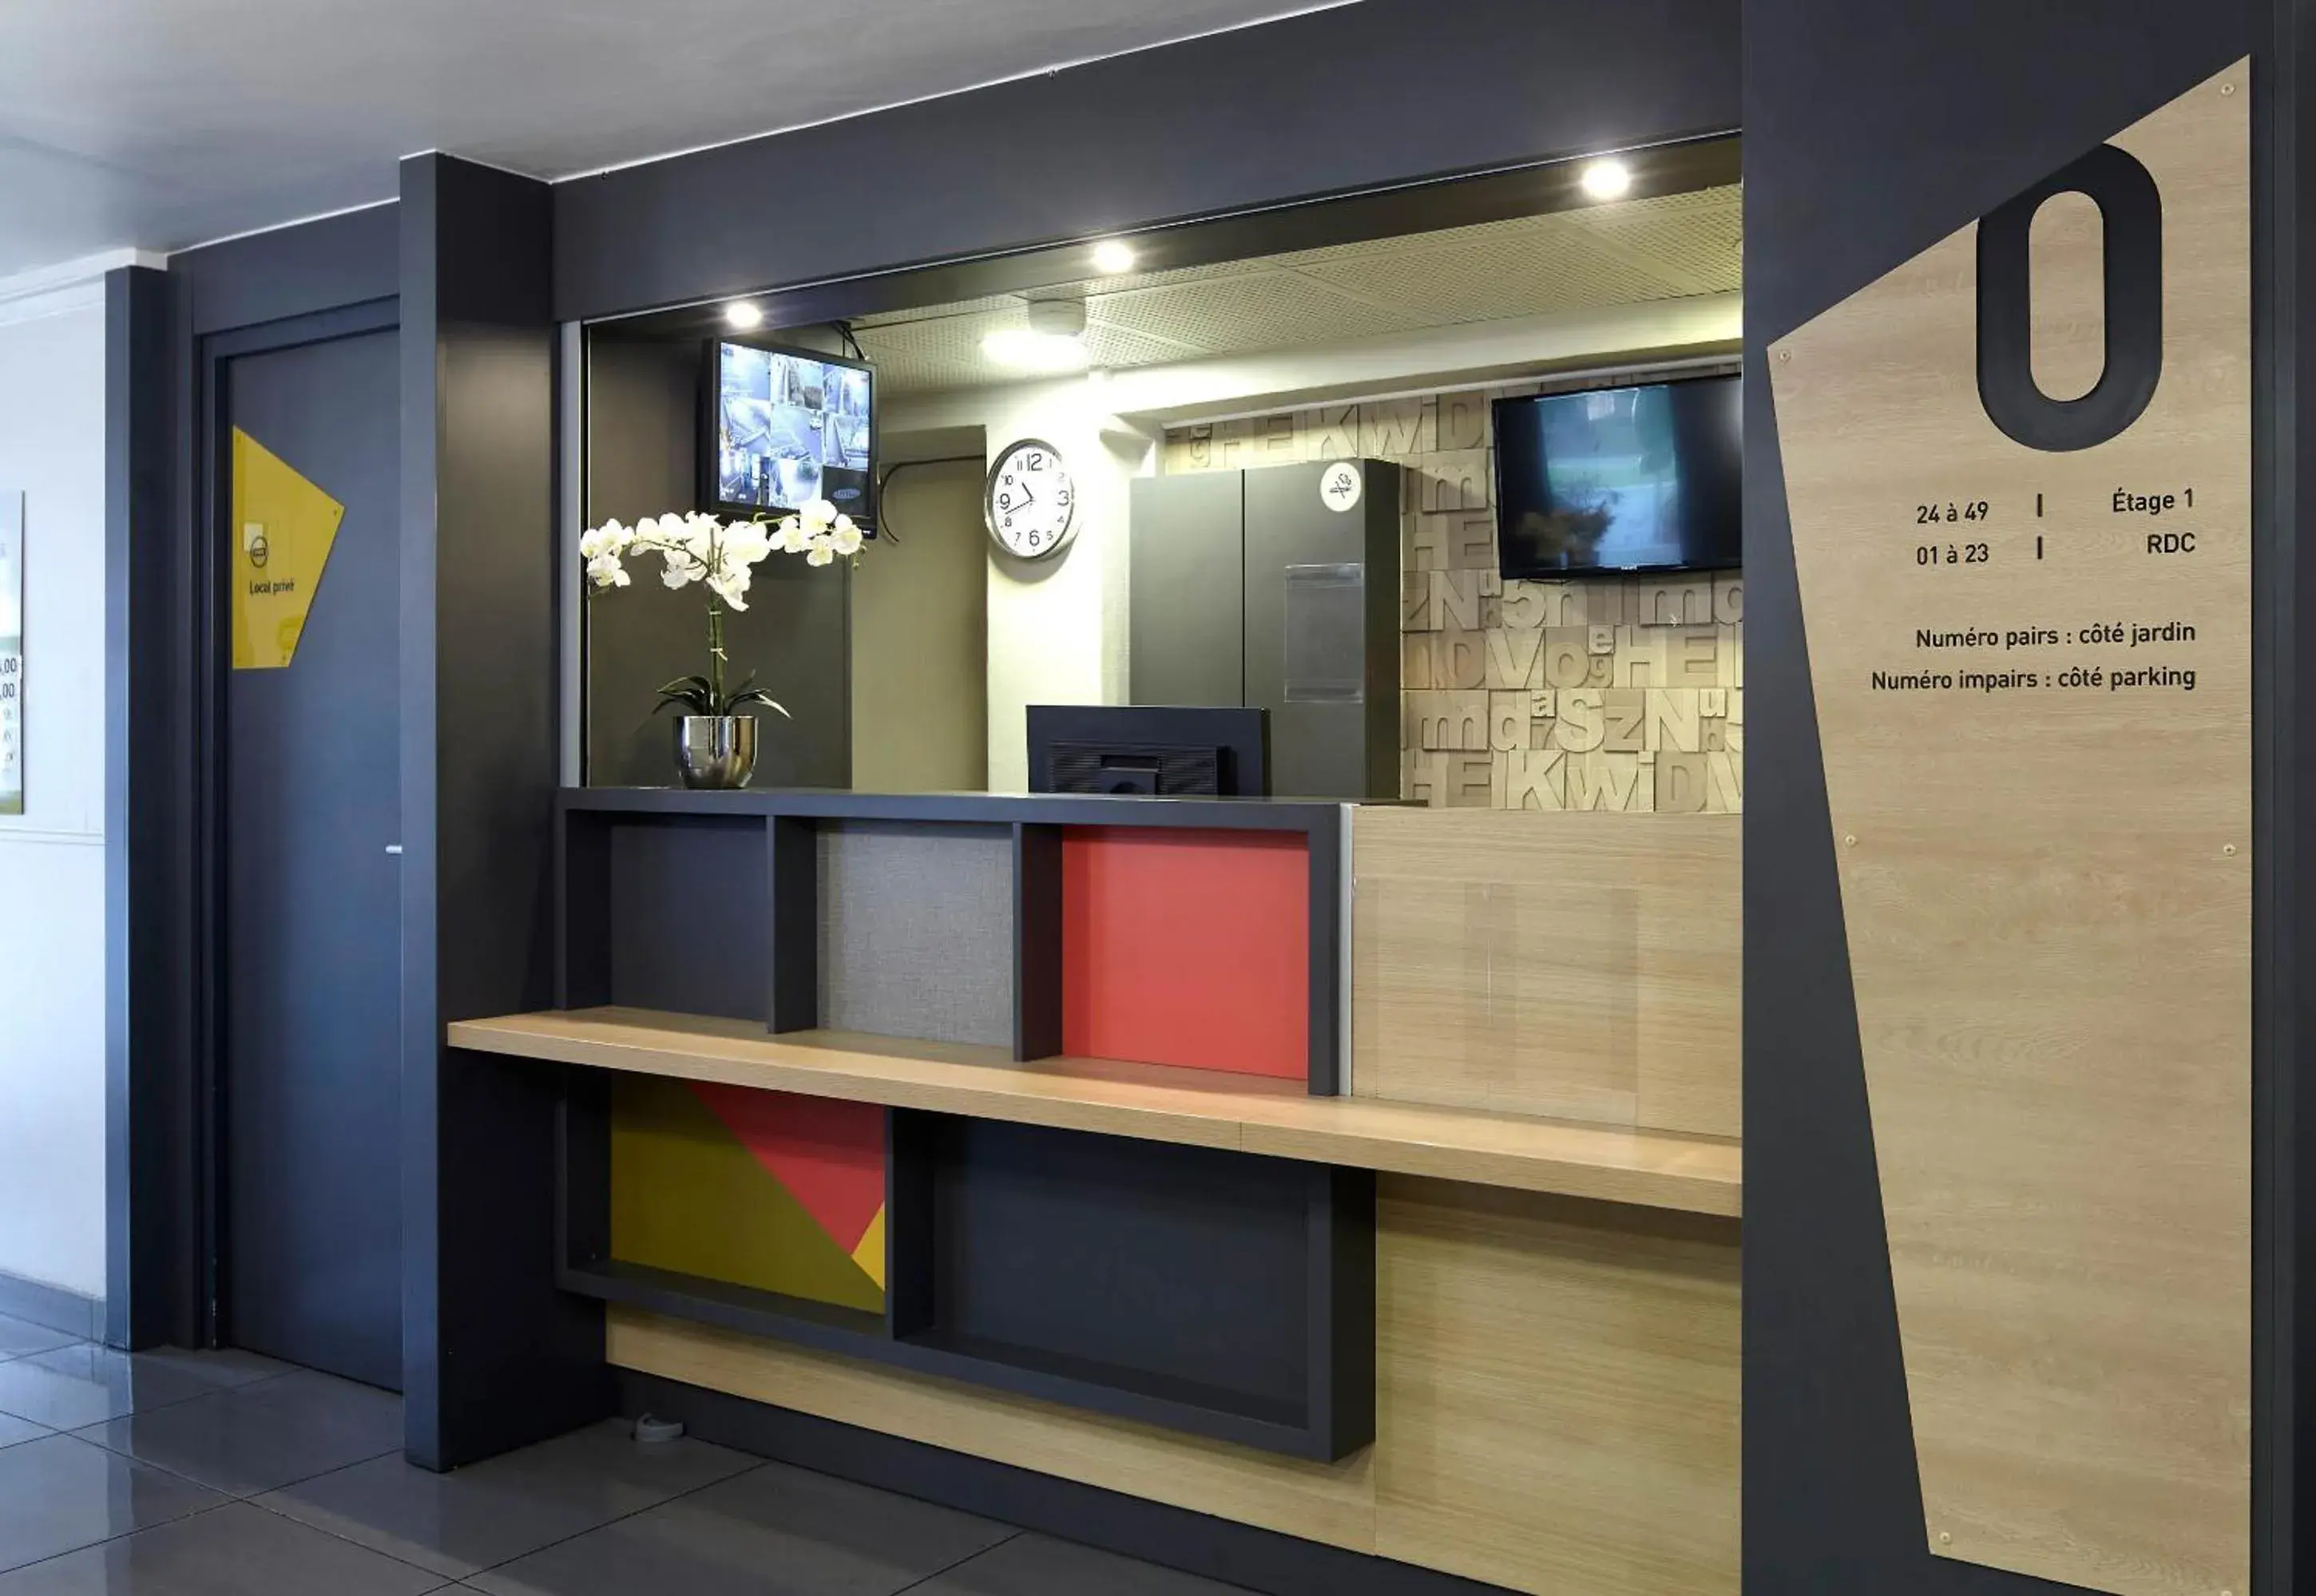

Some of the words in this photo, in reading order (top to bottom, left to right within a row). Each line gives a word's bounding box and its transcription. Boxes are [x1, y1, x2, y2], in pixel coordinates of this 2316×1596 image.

[1026, 453, 1043, 471] 12
[1004, 474, 1013, 485] 10
[999, 493, 1010, 510] 9
[1057, 489, 1069, 507] 3
[2112, 486, 2175, 516] Étage
[2184, 488, 2194, 508] 1
[1004, 517, 1013, 527] 8
[1917, 504, 1941, 525] 24
[1946, 502, 1958, 522] à
[1964, 501, 1989, 521] 49
[1029, 529, 1040, 546] 6
[1046, 530, 1054, 541] 5
[2147, 532, 2196, 554] RDC
[1917, 545, 1938, 566] 01
[1946, 544, 1958, 564] à
[1965, 542, 1989, 564] 23
[249, 580, 271, 596] Local
[272, 579, 295, 596] privé
[1916, 627, 1999, 648] Numéro
[2006, 625, 2059, 651] pairs
[2079, 621, 2125, 644] côté
[2129, 621, 2196, 648] jardin
[1872, 669, 1953, 691] Numéro
[1959, 669, 2038, 694] impairs
[2057, 666, 2103, 687] côté
[2110, 666, 2197, 692] parking
